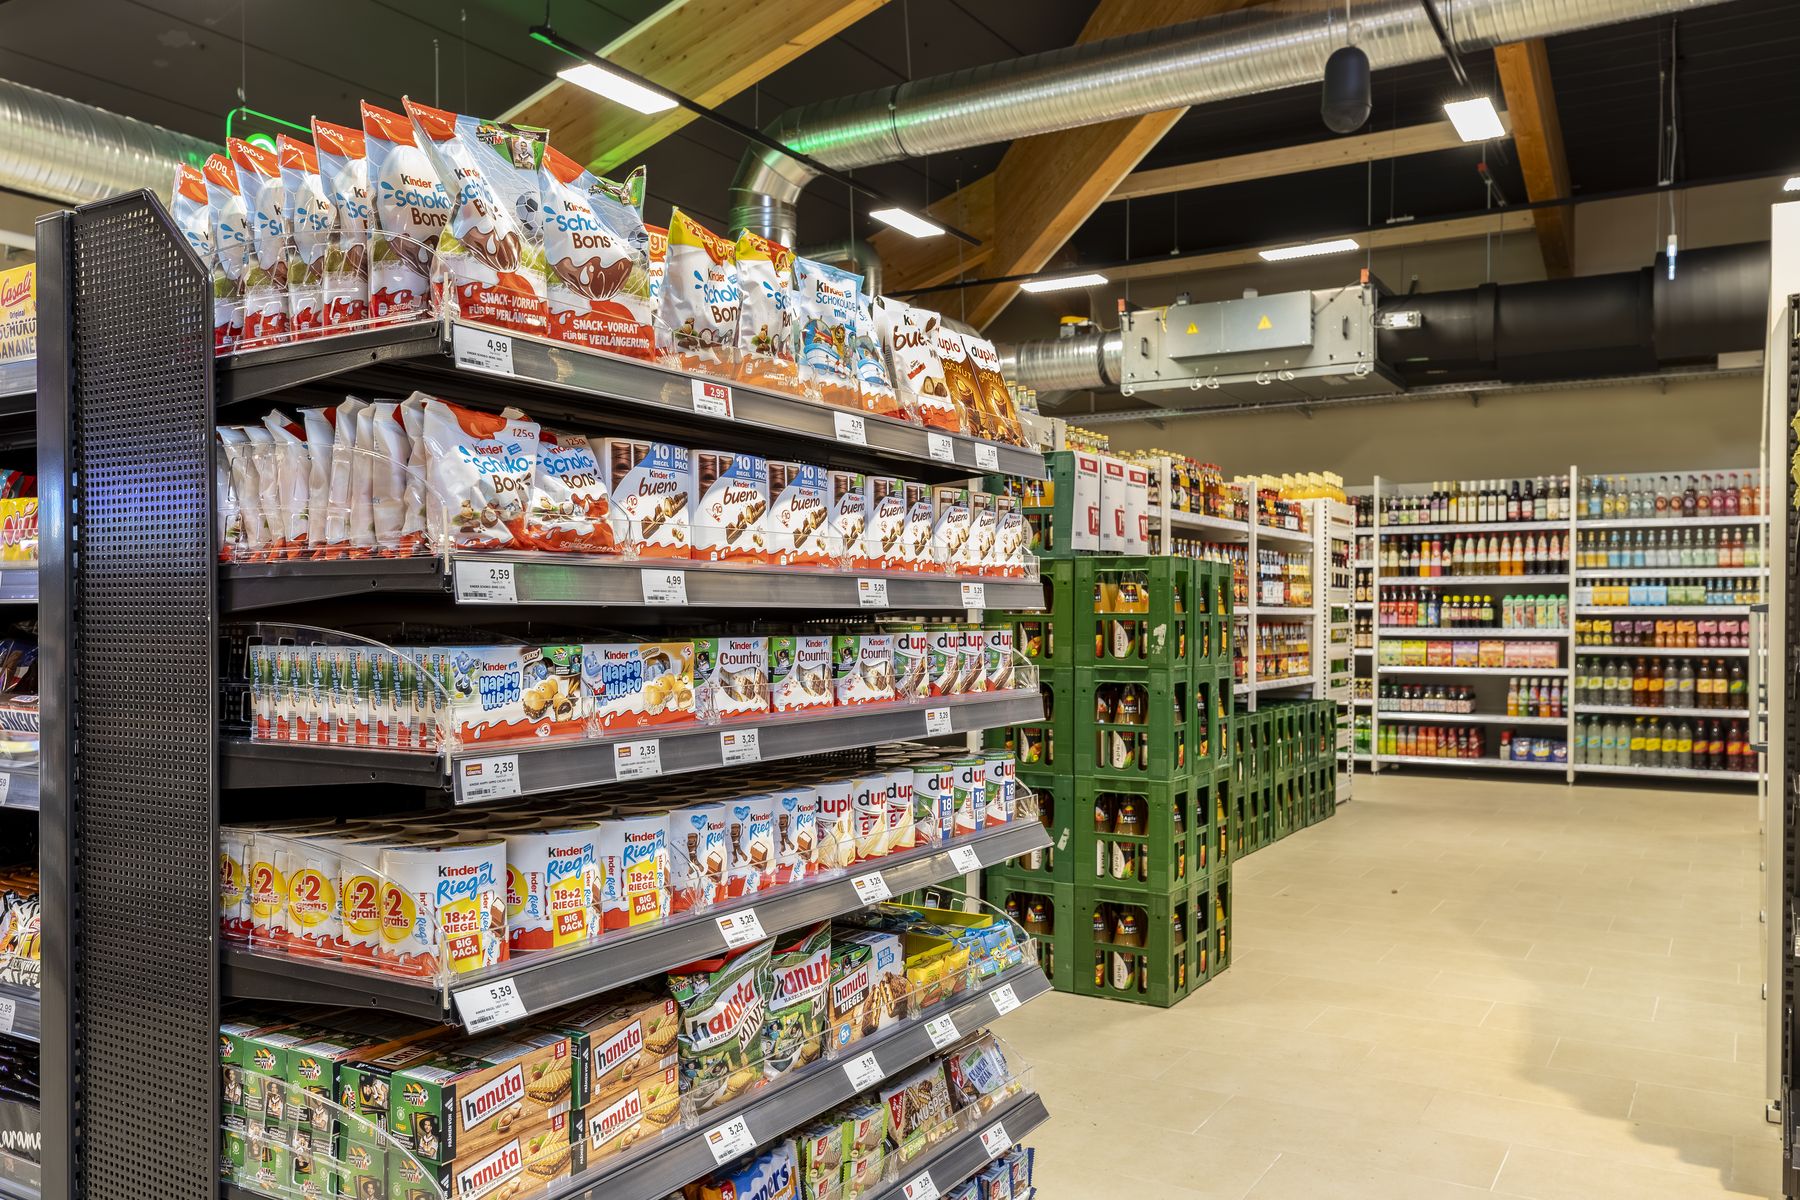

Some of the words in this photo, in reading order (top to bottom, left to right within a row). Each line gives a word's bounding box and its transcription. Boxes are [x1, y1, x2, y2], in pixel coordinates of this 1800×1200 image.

[401, 174, 431, 188] Kinder
[411, 208, 447, 226] Bons
[573, 233, 610, 248] Bons
[1, 270, 32, 306] Casali
[479, 292, 539, 310] SNACK-VORRAT
[573, 320, 638, 333] SNACK-VORRAT
[487, 339, 508, 352] 4,99
[563, 331, 576, 341] FÜR
[577, 332, 587, 341] DIE
[589, 333, 649, 348] VERLÄNGERUNG
[710, 387, 725, 398] 2,99
[512, 428, 534, 439] 125g
[566, 438, 585, 446] 125g
[473, 444, 503, 455] Kinder
[653, 445, 669, 459] 10
[736, 457, 750, 470] 10
[650, 469, 667, 479] Kinder
[802, 466, 814, 479] 10
[560, 473, 596, 489] Bons
[639, 477, 677, 497] bueno
[733, 479, 749, 488] Kinder
[723, 486, 757, 505] bueno
[799, 488, 813, 496] Kinder
[791, 495, 820, 512] bueno
[490, 568, 510, 581] 2,59
[666, 576, 681, 587] 4,99
[874, 583, 885, 592] 3,29
[730, 640, 751, 650] Kinder
[806, 639, 822, 648] Kinder
[868, 637, 885, 646] Kinder
[605, 649, 628, 660] Kinder
[720, 653, 761, 667] Country
[798, 650, 830, 662] Country
[860, 647, 891, 660] Country
[482, 662, 507, 671] Kinder
[602, 660, 642, 683] Happy
[480, 672, 520, 694] Happy
[482, 688, 520, 711] Hippo
[742, 734, 755, 744] 3,29
[640, 746, 656, 757] 2,39
[493, 761, 514, 774] 2,39
[624, 832, 656, 843] Kinder
[548, 847, 583, 858] Kinder
[623, 829, 667, 866] Riegel
[546, 845, 596, 883] Riegel
[438, 865, 479, 878] Kinder
[630, 871, 654, 882] 18+2
[295, 875, 321, 901] +2
[436, 863, 496, 907] Riegel
[628, 880, 656, 891] RIEGEL
[870, 877, 882, 886] 3,29
[351, 882, 376, 909] +2
[555, 888, 581, 900] 18+2
[639, 894, 652, 904] BIG
[296, 902, 328, 913] gratis
[383, 888, 403, 917] +2
[552, 898, 584, 910] RIEGEL
[636, 902, 657, 913] PACK
[383, 917, 409, 928] gratis
[444, 912, 476, 924] 18+2
[560, 913, 578, 924] BIG
[739, 914, 755, 925] 3,29
[443, 922, 480, 934] RIEGEL
[560, 921, 584, 933] PACK
[455, 934, 472, 949] BIG
[453, 946, 478, 959] PACK
[490, 985, 512, 999] 5,39
[835, 971, 867, 1001] hanuta
[667, 1002, 673, 1011] 10
[841, 992, 864, 1014] RIEGEL
[692, 979, 755, 1042] hanuta
[557, 1043, 565, 1054] 10
[598, 1027, 641, 1070] hanuta
[862, 1057, 874, 1068] 3,19
[667, 1070, 673, 1079] 10
[410, 1096, 425, 1106] WM
[465, 1073, 521, 1122] hanuta
[593, 1094, 639, 1135] hanuta
[910, 1091, 950, 1129] KNUSPER
[554, 1117, 562, 1125] 10
[728, 1122, 744, 1135] 3,29
[461, 1146, 519, 1194] hanuta
[919, 1177, 930, 1188] 2,29
